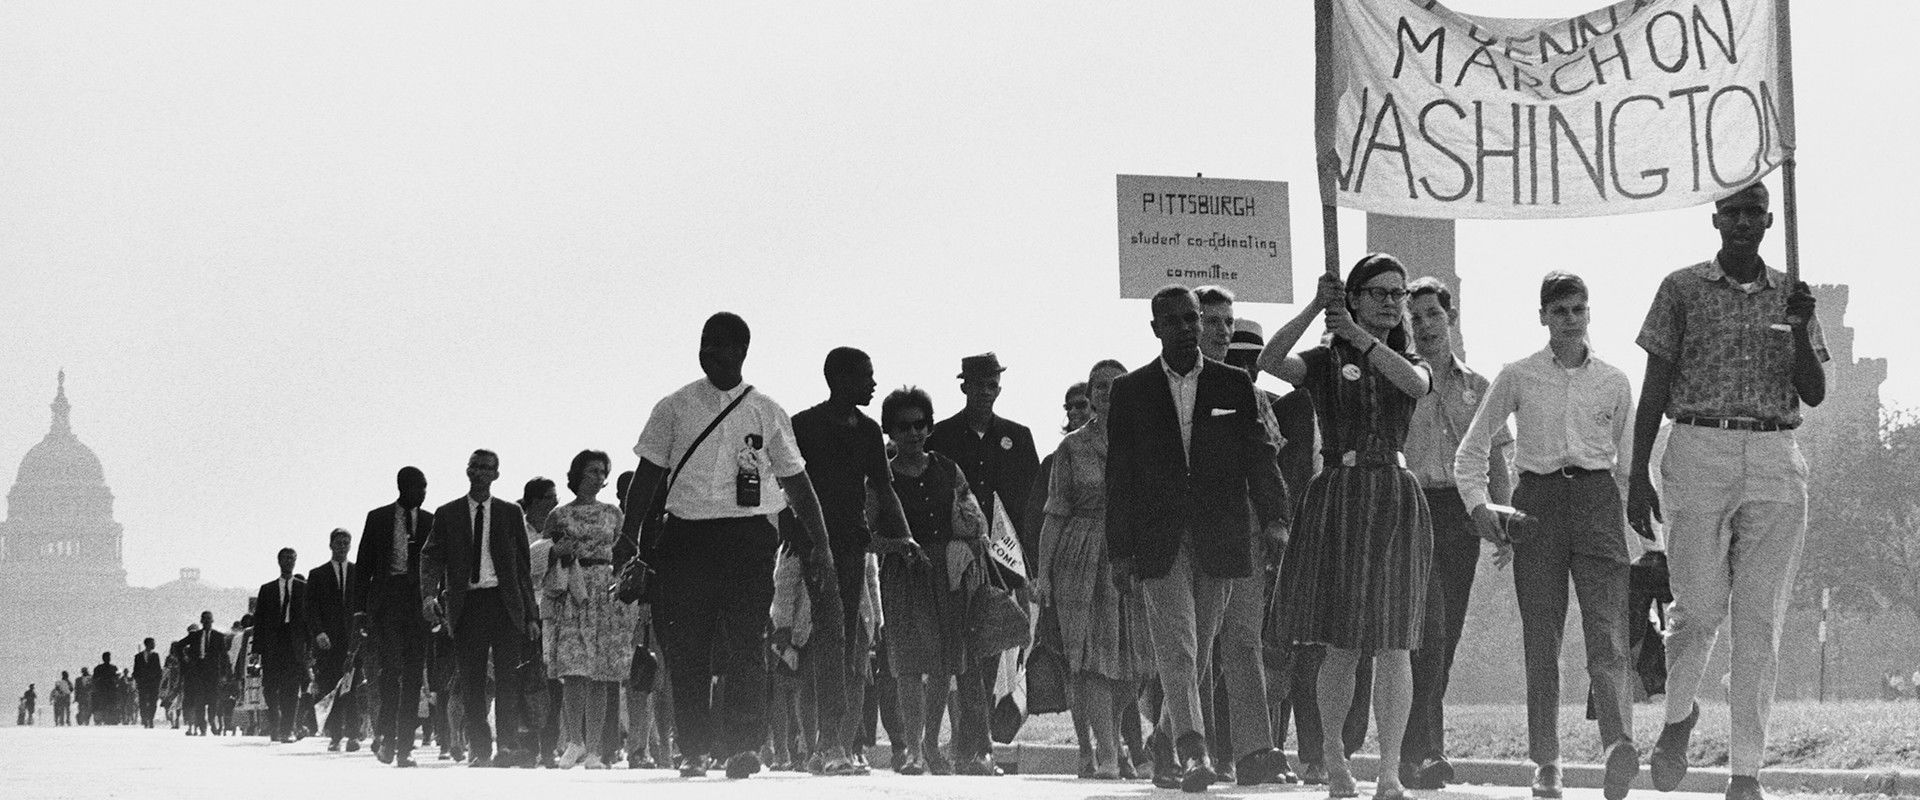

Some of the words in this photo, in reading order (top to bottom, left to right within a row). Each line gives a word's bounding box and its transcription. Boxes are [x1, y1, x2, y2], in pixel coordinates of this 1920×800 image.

[1393, 16, 1632, 101] MARCH
[1645, 0, 1738, 74] ON
[1142, 192, 1256, 217] PITTSBURGH
[1130, 231, 1182, 247] student
[1166, 264, 1239, 280] committee
[1000, 535, 1017, 551] all
